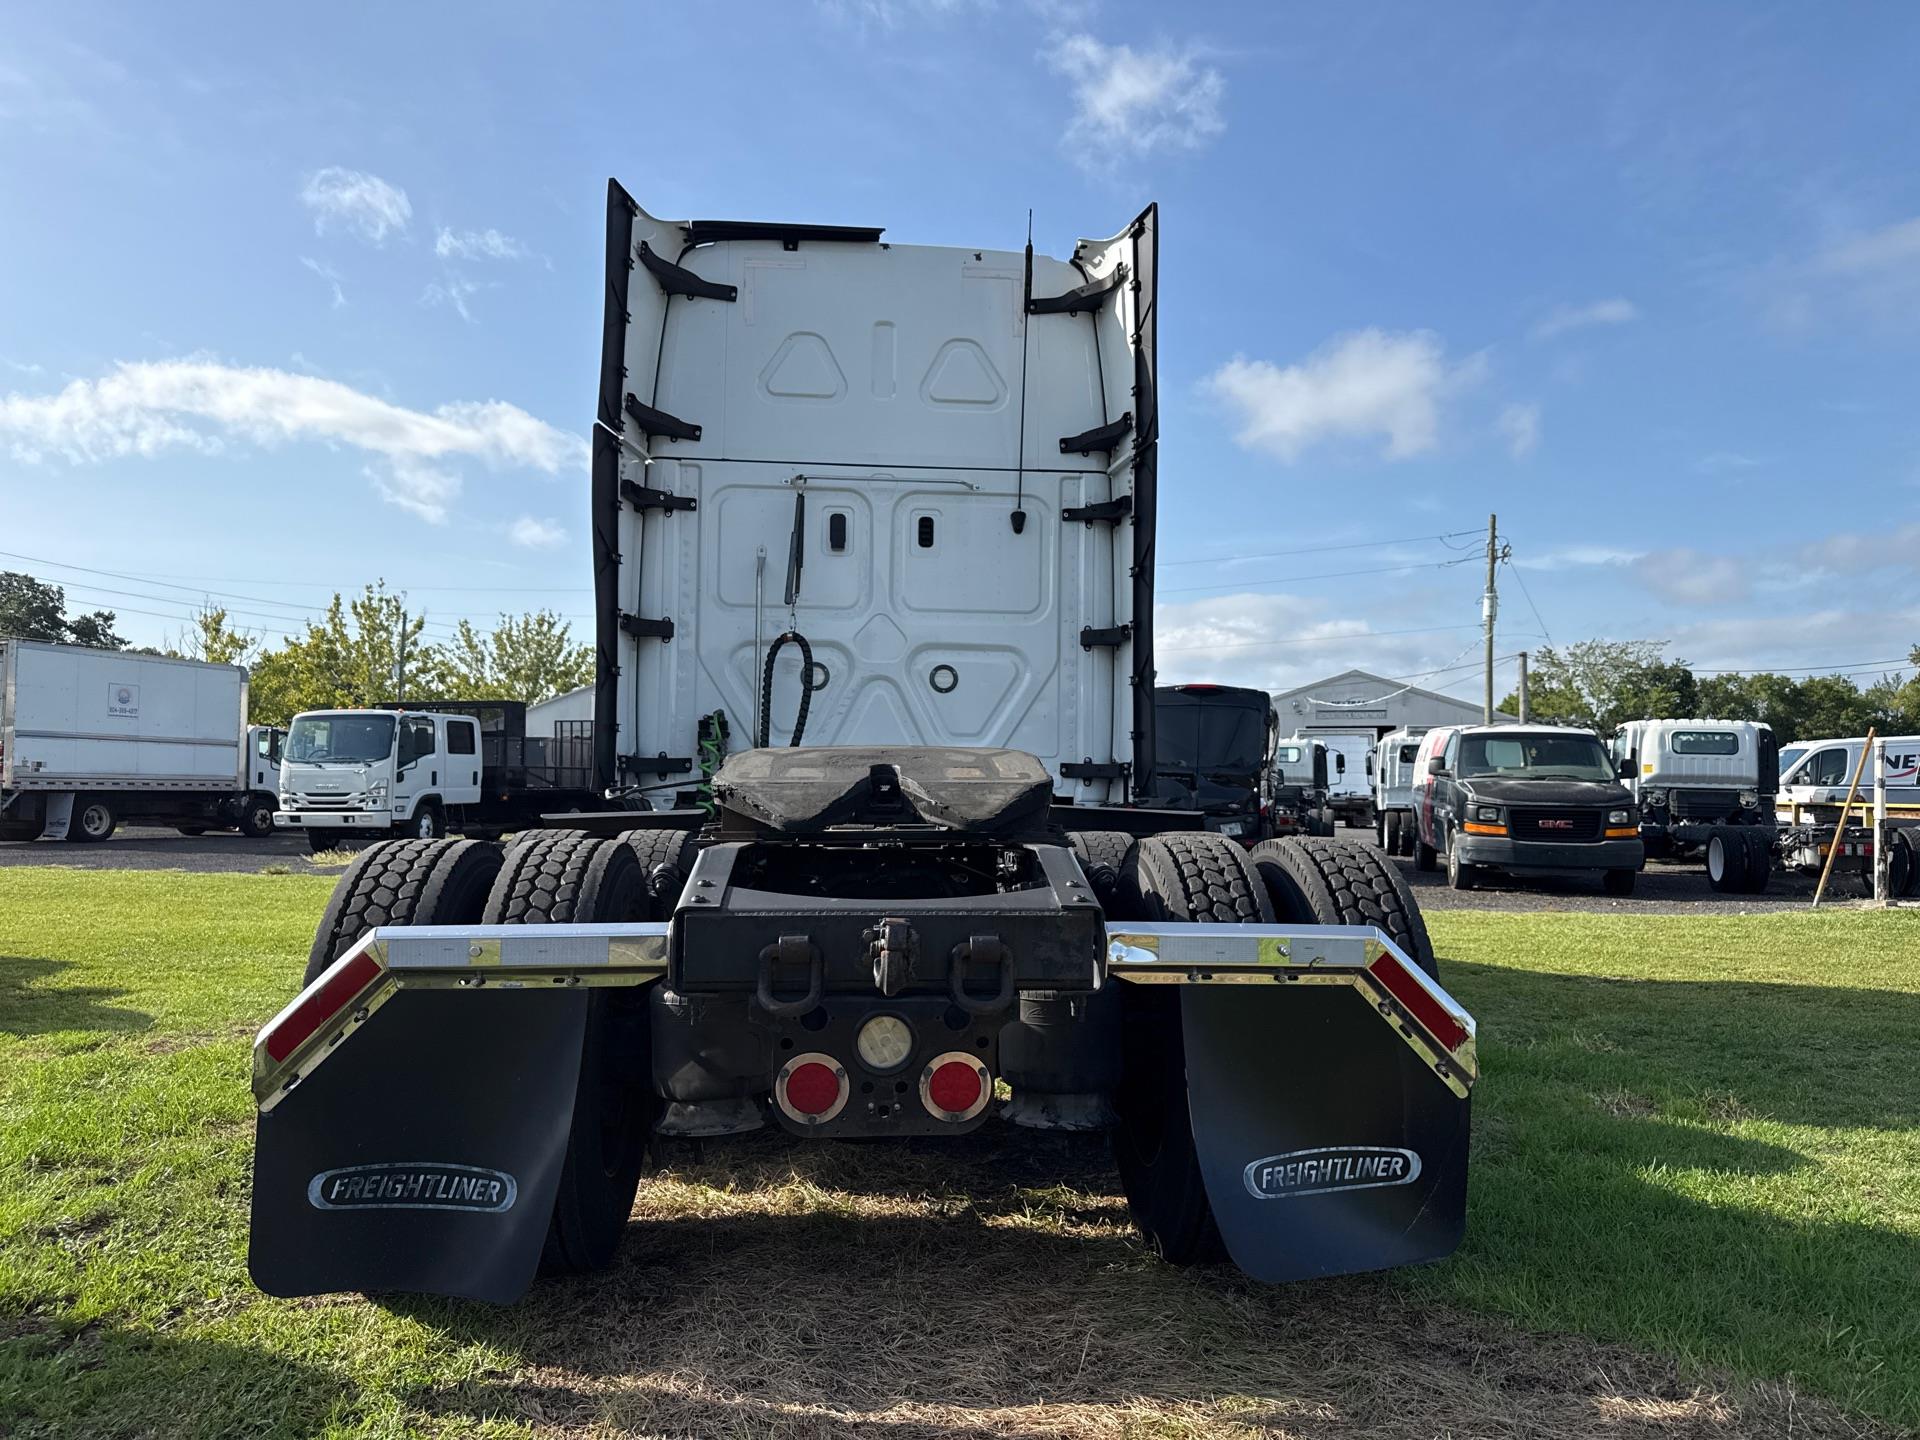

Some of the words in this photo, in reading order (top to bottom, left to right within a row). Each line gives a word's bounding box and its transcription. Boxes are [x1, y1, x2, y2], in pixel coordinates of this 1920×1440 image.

[1886, 754, 1920, 769] NE
[1538, 820, 1573, 828] GMC
[1262, 1157, 1403, 1189] FREIGHTLINER
[331, 1175, 500, 1201] FREIGHTLINER
